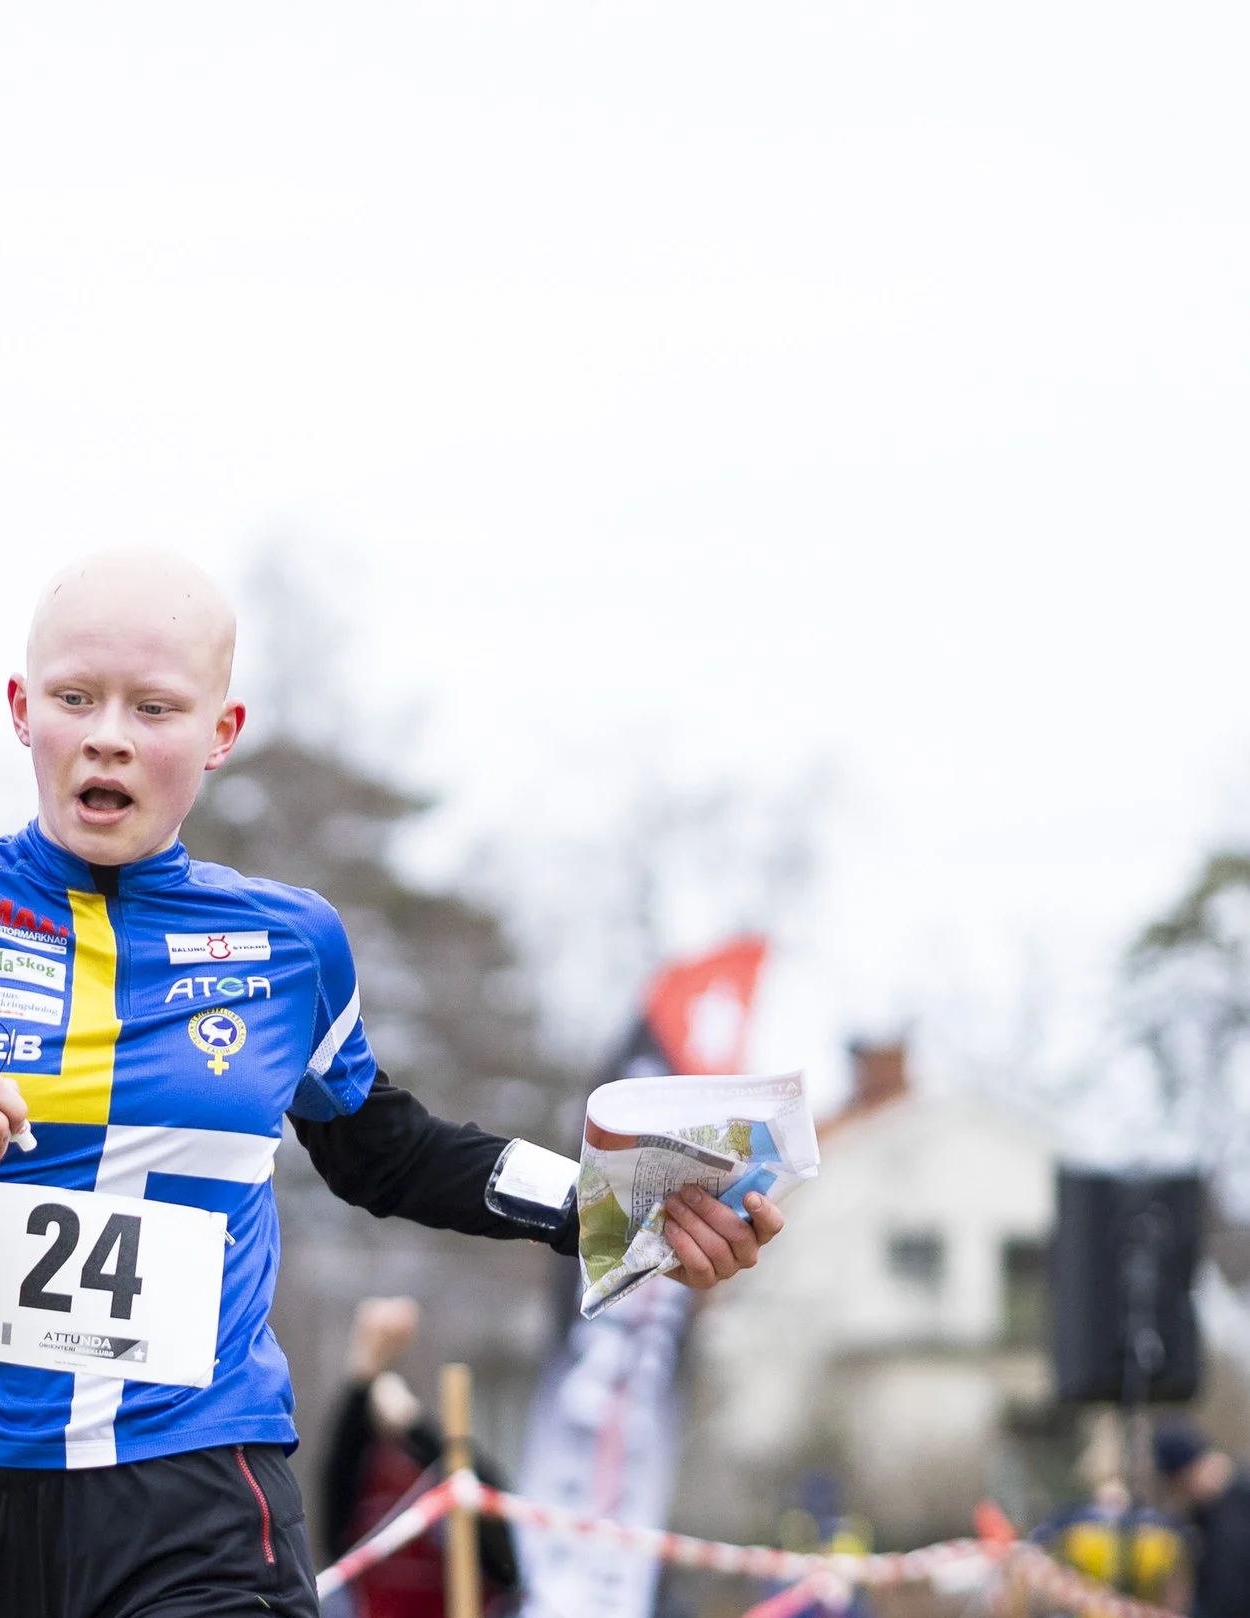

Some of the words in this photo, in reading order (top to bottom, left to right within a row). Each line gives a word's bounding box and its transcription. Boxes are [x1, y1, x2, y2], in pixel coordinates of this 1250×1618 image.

[19, 1203, 142, 1320] 24
[44, 1331, 112, 1349] ATTUNDA
[39, 1342, 115, 1357] ORIENTERIKLUBB
